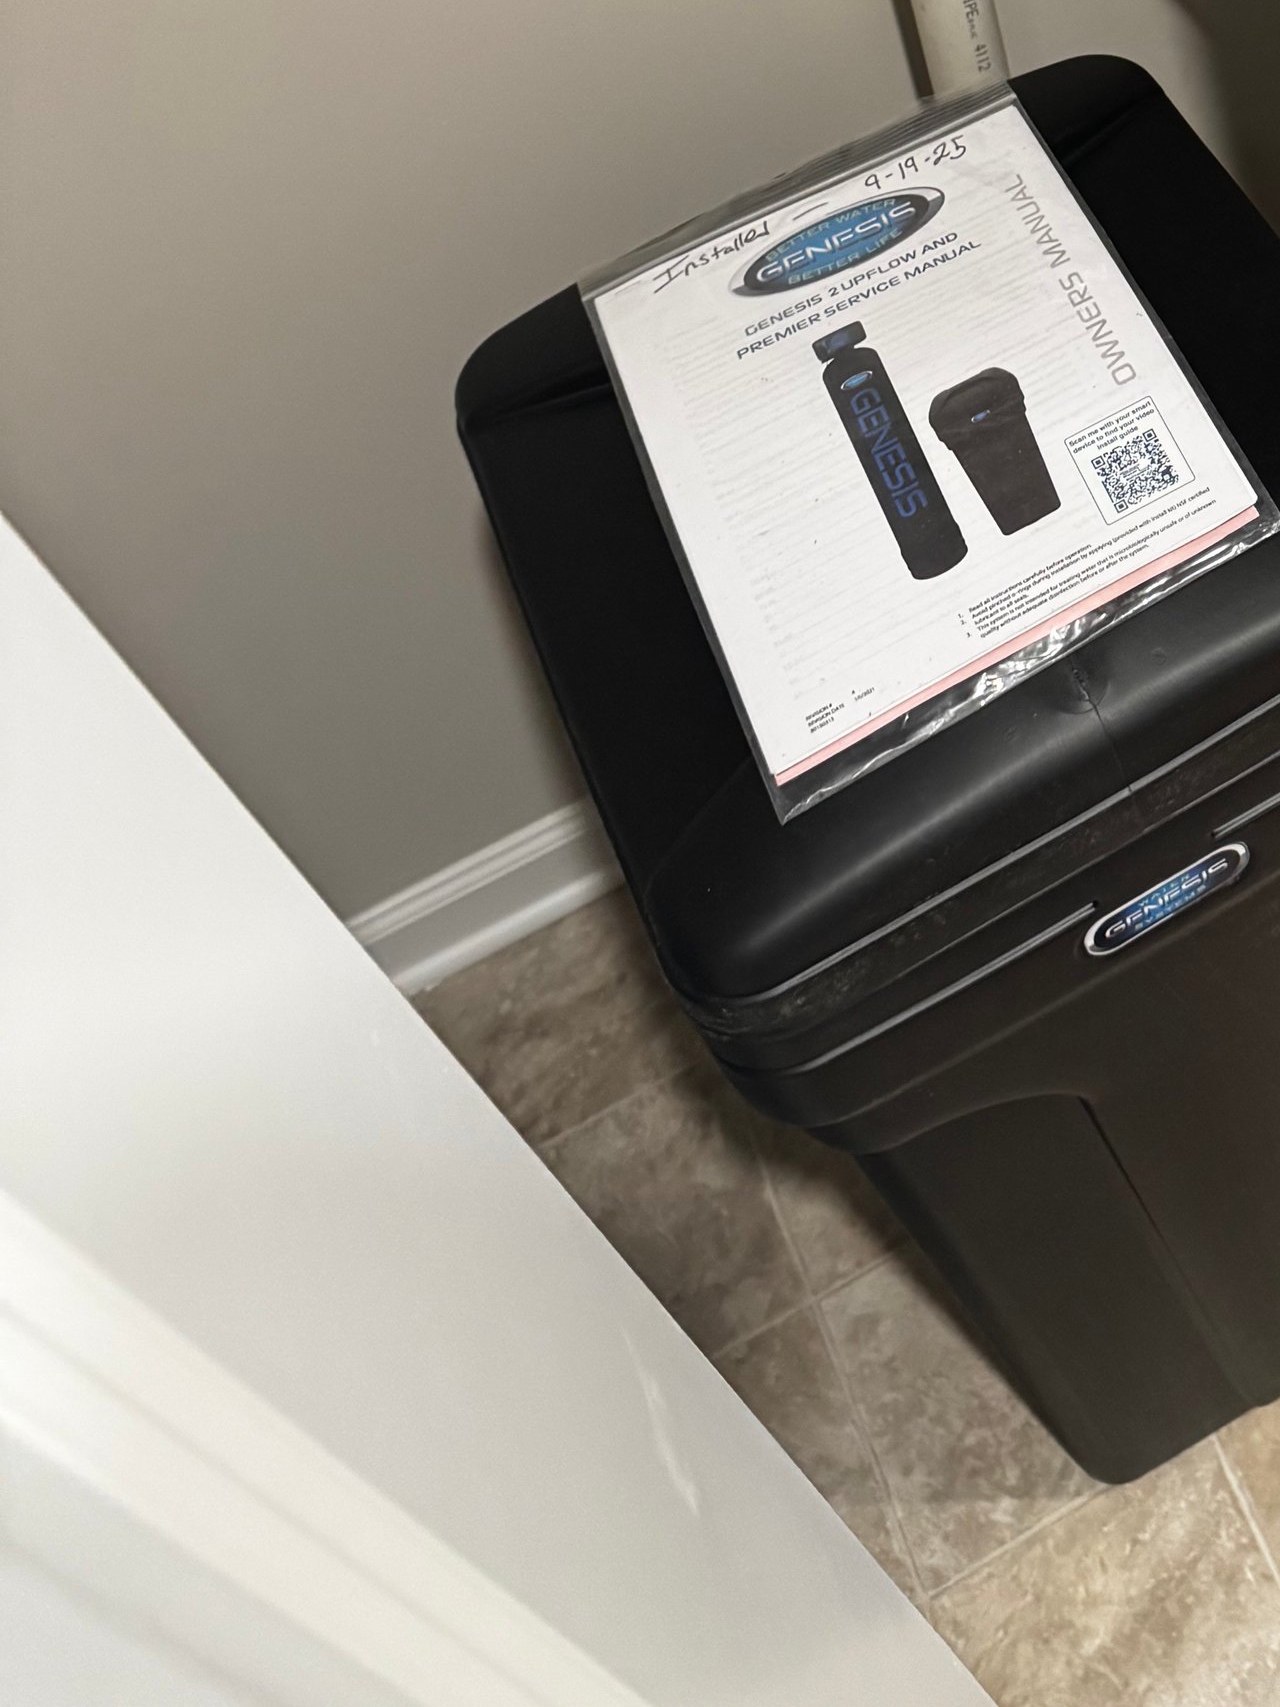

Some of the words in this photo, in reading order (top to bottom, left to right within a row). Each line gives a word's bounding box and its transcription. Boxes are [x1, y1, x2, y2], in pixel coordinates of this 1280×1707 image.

[864, 134, 967, 189] 9-19-25
[754, 200, 917, 284] GENESIS
[764, 221, 830, 262] BETTER
[834, 196, 897, 224] WATER
[786, 252, 860, 285] BETTER
[865, 227, 903, 253] LIFE
[1009, 174, 1070, 270] MANUAL
[736, 312, 821, 359] PREMIER
[823, 275, 900, 317] SERVICE
[904, 238, 981, 280] MANUAL
[743, 293, 822, 337] GENESIS
[827, 286, 840, 298] 2
[840, 250, 918, 291] UPFLOW
[919, 231, 958, 254] AND
[1059, 270, 1137, 386] OWNERS
[849, 386, 928, 518] GENESIS
[1069, 435, 1086, 447] Scan
[1087, 429, 1099, 437] me
[1099, 421, 1114, 431] with
[1115, 412, 1130, 424] your
[1131, 401, 1151, 414] smart
[1073, 439, 1095, 454] device
[1104, 426, 1118, 437] find
[1119, 419, 1134, 430] your
[1135, 409, 1154, 420] video
[1119, 426, 1138, 439] guide
[1105, 858, 1228, 938] GENESIS
